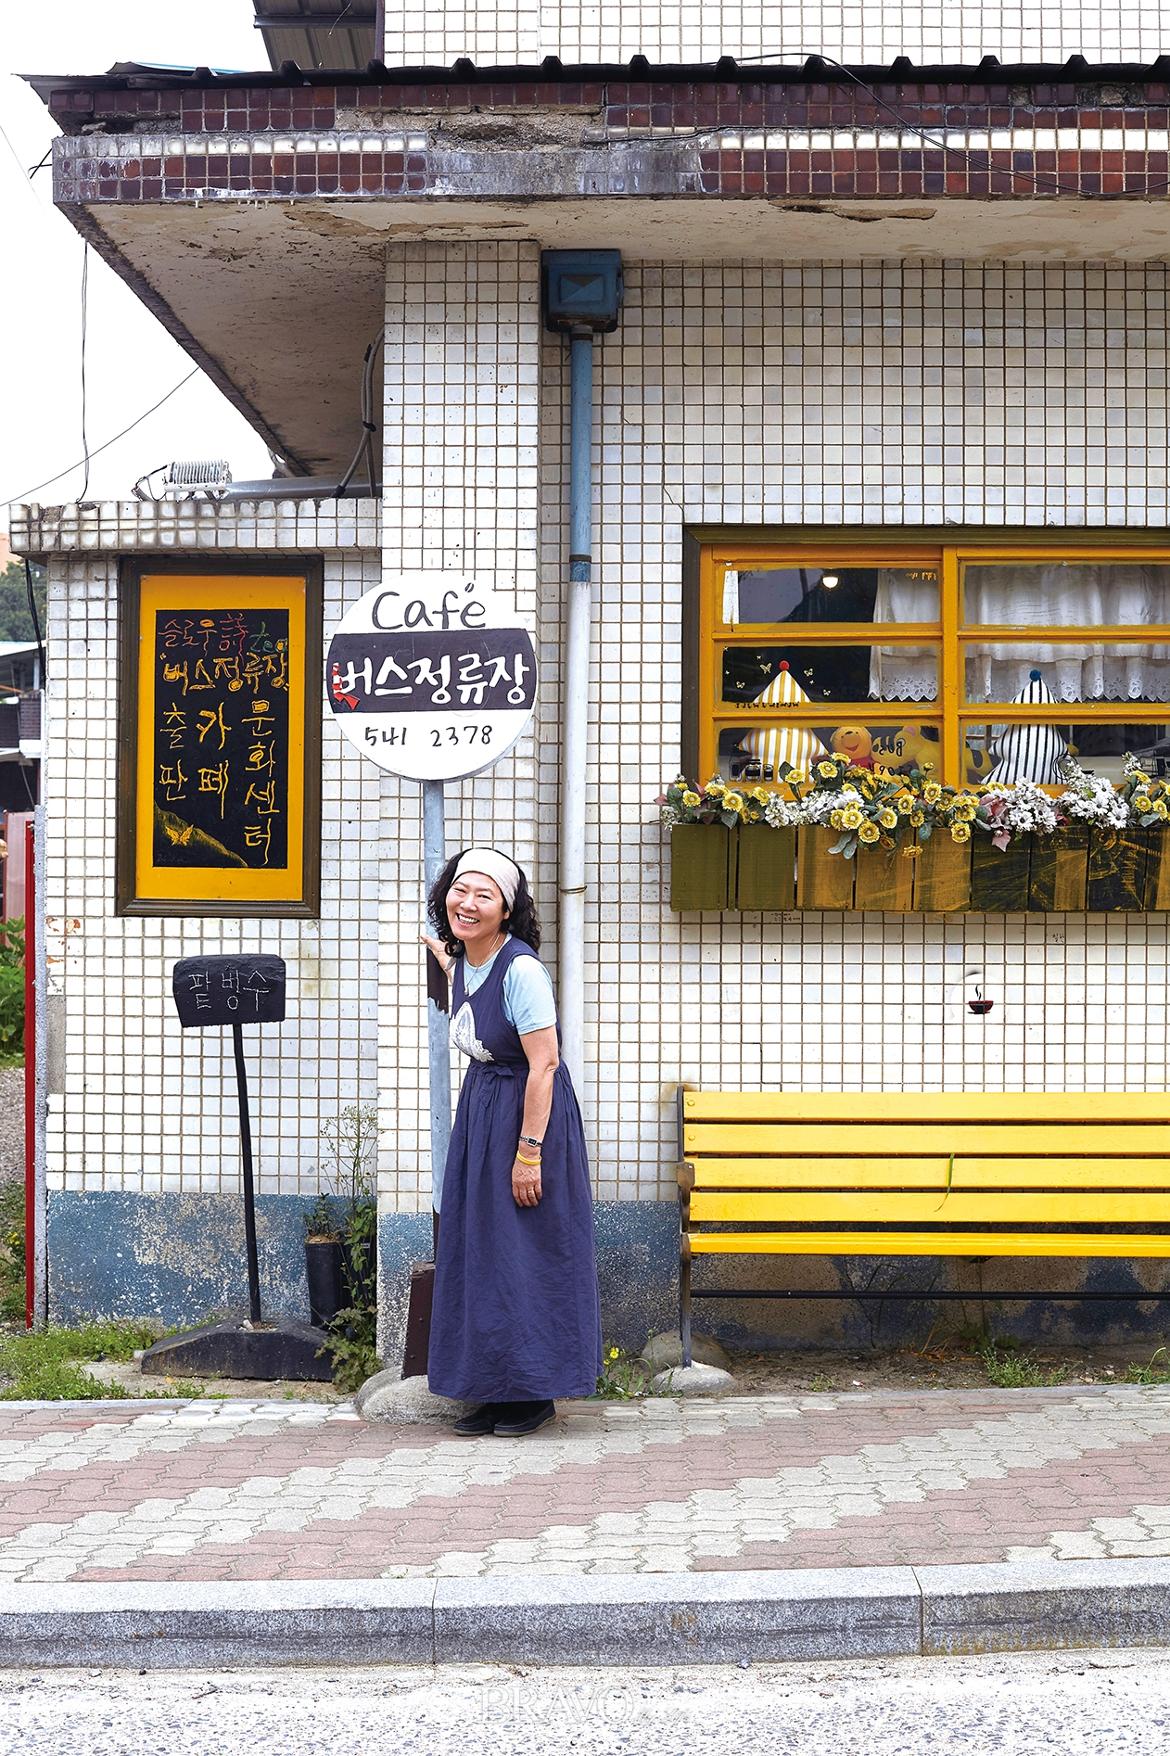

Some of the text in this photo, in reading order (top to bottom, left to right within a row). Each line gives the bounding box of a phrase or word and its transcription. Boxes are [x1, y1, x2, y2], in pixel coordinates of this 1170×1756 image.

[371, 582, 486, 630] Café
[332, 653, 530, 706] 버스정류장
[159, 702, 189, 801] 출판
[195, 702, 232, 819] 카페
[365, 725, 493, 747] 541 2378
[241, 700, 280, 866] 문화센터
